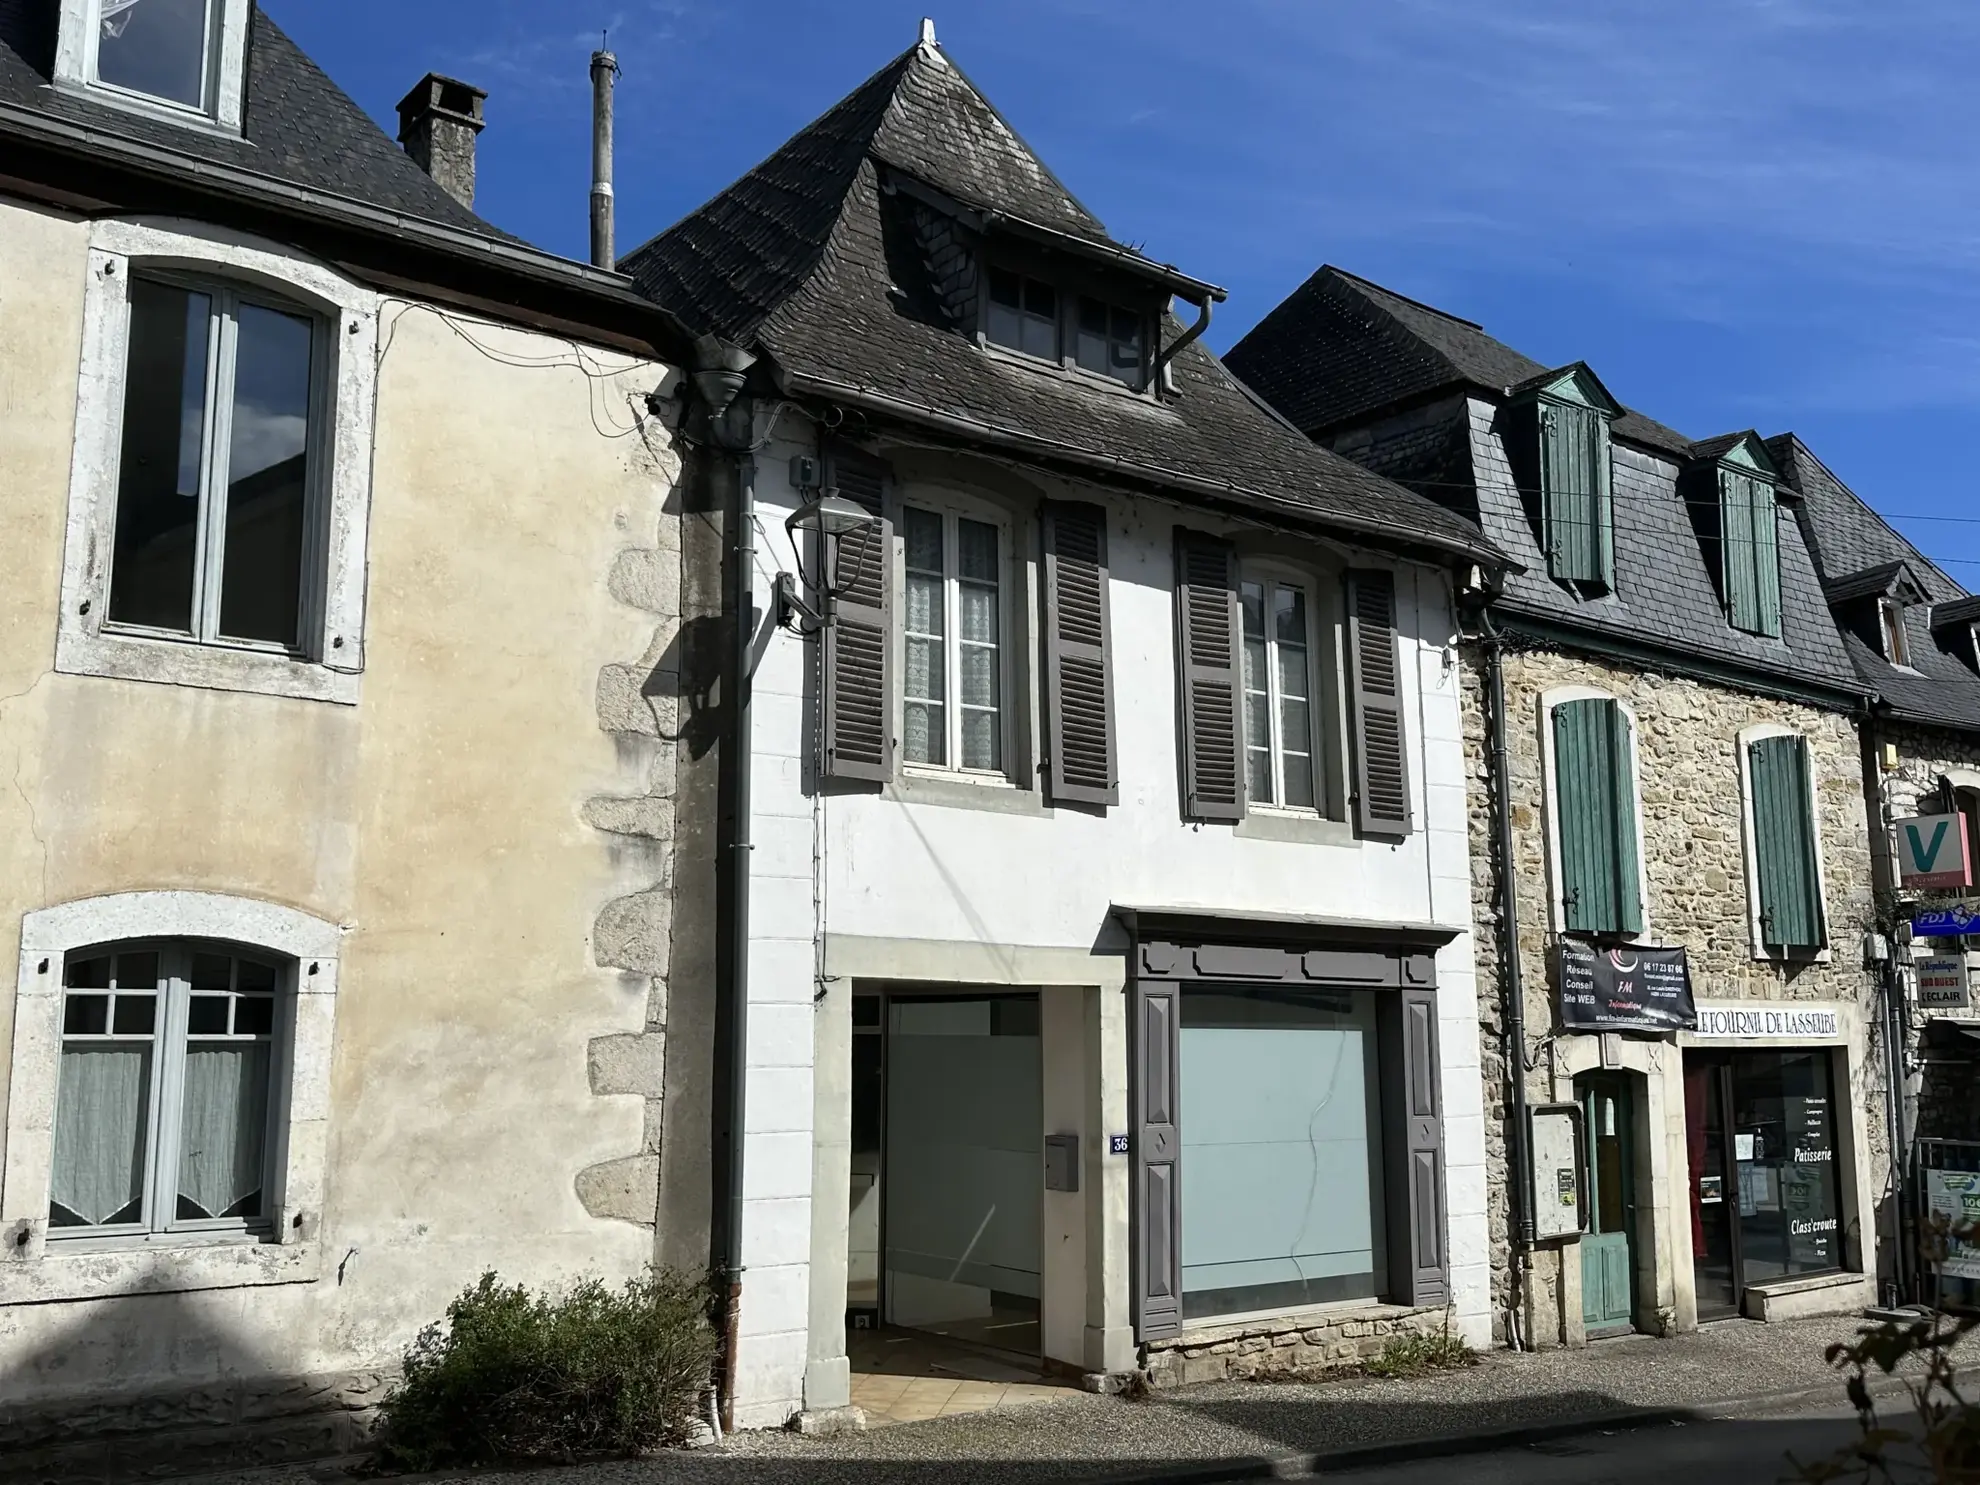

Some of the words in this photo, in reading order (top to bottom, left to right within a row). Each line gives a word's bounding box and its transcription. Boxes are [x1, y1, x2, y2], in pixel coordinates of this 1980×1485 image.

[1905, 821, 1949, 873] V
[1919, 911, 1946, 924] FDJ
[1562, 949, 1595, 962] Formation
[1566, 965, 1592, 976] Réseau
[1652, 962, 1659, 972] 17
[1659, 963, 1667, 973] 23
[1566, 978, 1594, 990] Conseil
[1934, 976, 1959, 987] OUEST
[1563, 993, 1576, 1003] Site
[1577, 994, 1596, 1004] WEB
[1696, 1011, 1708, 1033] LE
[1710, 1010, 1763, 1034] FOURNIL
[1766, 1012, 1782, 1033] DE
[1785, 1012, 1836, 1033] LASSEUBE
[1114, 1137, 1128, 1151] 36
[1794, 1146, 1832, 1163] Patisserie
[1790, 1217, 1837, 1236] Class'croute
